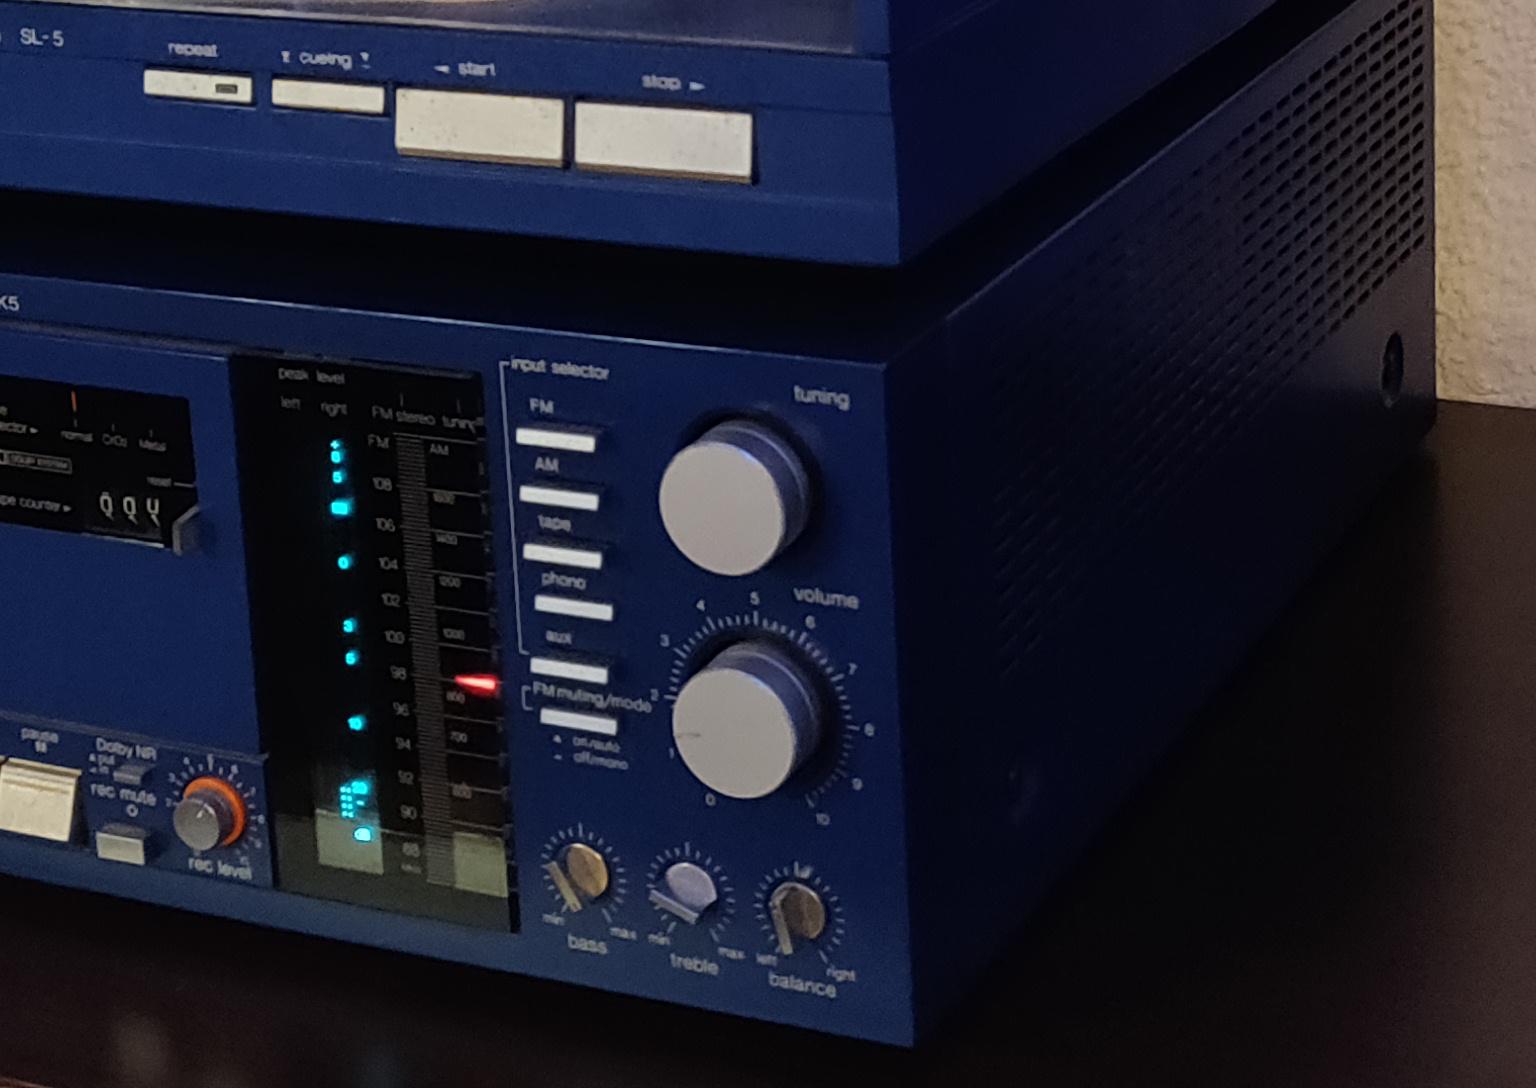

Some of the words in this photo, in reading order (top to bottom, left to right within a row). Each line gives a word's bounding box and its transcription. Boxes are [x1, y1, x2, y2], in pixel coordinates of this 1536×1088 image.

[168, 42, 218, 58] repeat
[299, 51, 352, 71] cueing
[458, 61, 496, 78] start
[641, 74, 682, 91] stop
[278, 367, 309, 381] peak
[316, 369, 346, 385] level
[511, 356, 546, 374] input
[551, 360, 611, 381] selector
[281, 396, 301, 410] left
[529, 397, 555, 414] FM
[794, 384, 851, 411] tuning
[321, 401, 348, 418] right
[372, 405, 393, 421] FM
[396, 411, 436, 427] stereo
[368, 434, 390, 449] FM
[429, 444, 450, 457] AM
[535, 457, 560, 473] AM
[372, 476, 393, 492] 108
[19, 497, 62, 513] counter
[375, 517, 396, 533] 106
[538, 514, 572, 533] tape
[378, 557, 399, 571] 104
[541, 570, 587, 591] phono
[381, 592, 401, 608] 102
[696, 598, 706, 612] 4
[750, 592, 761, 605] 5
[793, 586, 860, 610] volume
[805, 615, 816, 629] 6
[384, 630, 406, 645] 100
[545, 629, 573, 645] aux
[660, 634, 670, 647] 3
[390, 665, 407, 681] 98
[849, 663, 858, 676] 7
[533, 680, 559, 698] FM
[560, 686, 653, 715] muting/mode
[393, 701, 410, 717] 96
[864, 723, 876, 737] 8
[95, 736, 134, 760] Dolby
[136, 743, 158, 761] NR
[395, 737, 412, 751] 94
[572, 736, 621, 754] on/auto
[573, 750, 630, 771] off/mono
[852, 778, 863, 792] 9
[90, 782, 116, 799] rec
[119, 787, 158, 808] mute
[704, 793, 716, 807] 0
[400, 805, 418, 821] 90
[815, 813, 831, 827] 10
[188, 856, 213, 873] rec
[216, 859, 253, 882] level
[541, 912, 565, 926] min
[609, 926, 638, 942] max
[647, 931, 672, 946] min
[567, 933, 609, 956] bass
[717, 945, 746, 961] max
[669, 952, 721, 976] treble
[826, 966, 858, 984] right
[769, 972, 838, 999] balance
